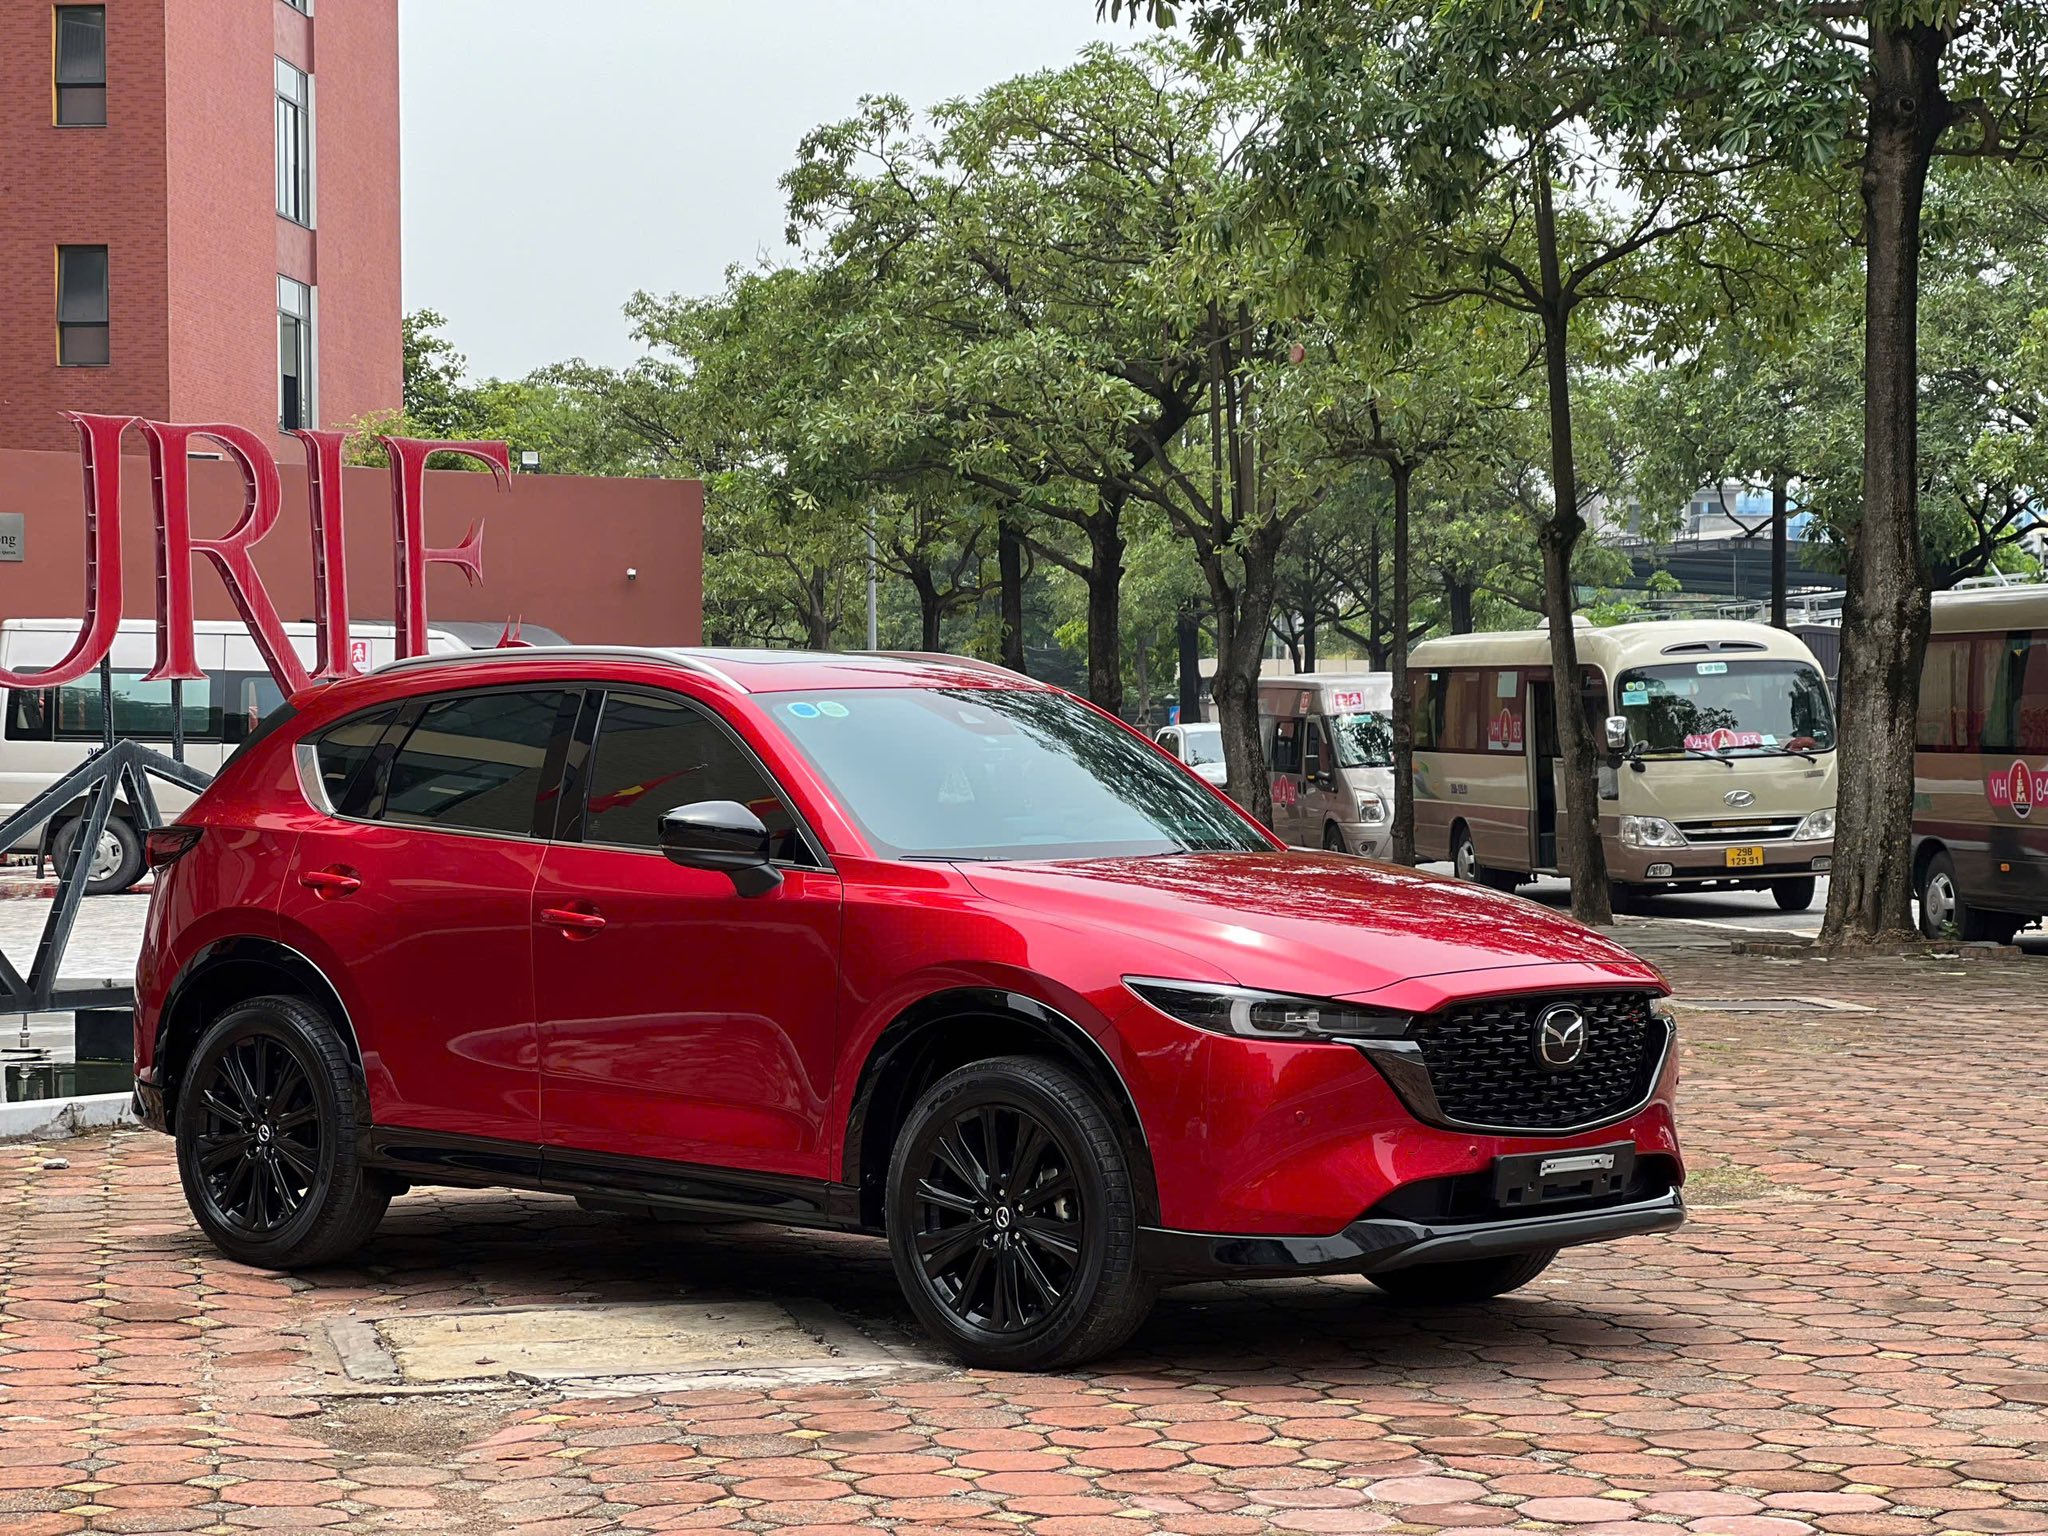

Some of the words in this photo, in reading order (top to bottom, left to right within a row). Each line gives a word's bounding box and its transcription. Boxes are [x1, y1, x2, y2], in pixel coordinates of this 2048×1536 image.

[0, 535, 16, 548] ng
[1512, 721, 1522, 739] 83
[1689, 738, 1709, 750] VH
[1741, 735, 1758, 746] 83
[1991, 778, 2008, 799] VH
[1736, 847, 1753, 857] 29B
[1731, 856, 1759, 866] 129.91
